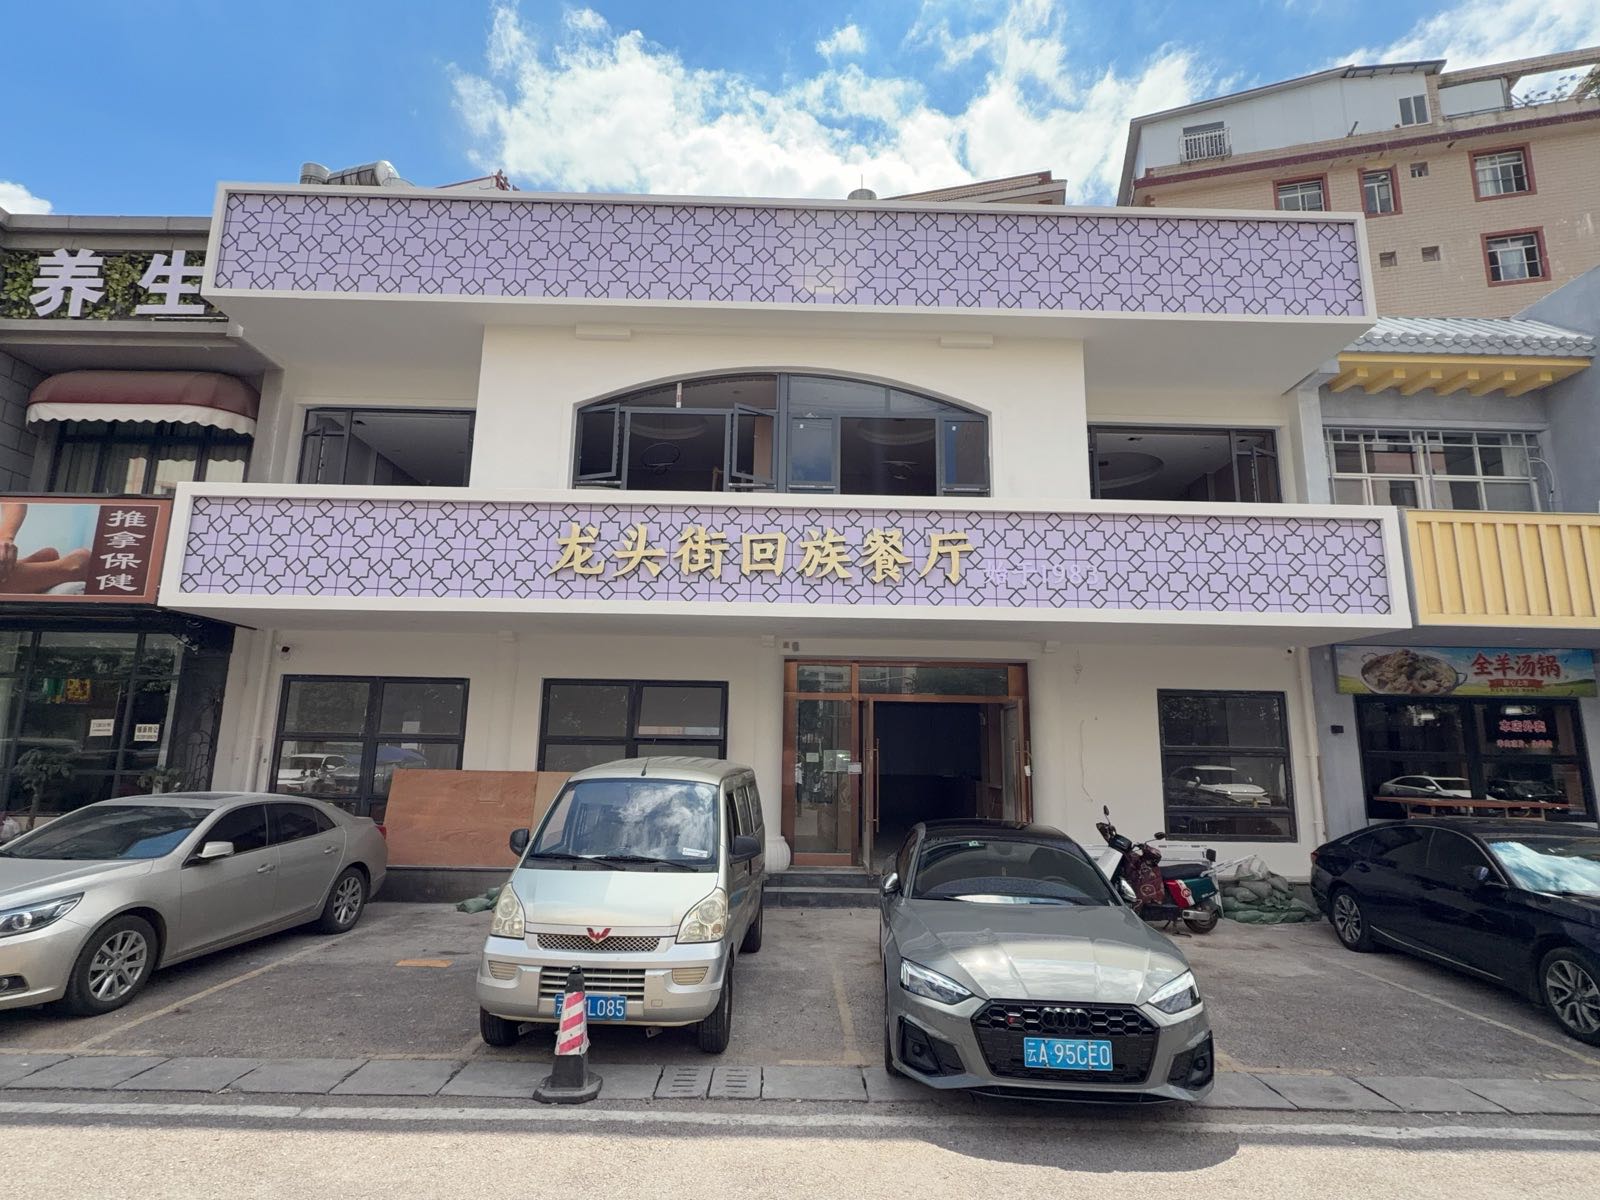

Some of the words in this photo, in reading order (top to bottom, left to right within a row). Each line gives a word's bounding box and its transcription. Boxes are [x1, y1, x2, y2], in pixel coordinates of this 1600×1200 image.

[30, 249, 205, 317] 养生
[96, 510, 148, 592] 推拿保健
[548, 523, 976, 585] 龙头街回族餐厅
[984, 560, 1098, 585] 始于1983
[1470, 651, 1562, 679] 全羊汤锅
